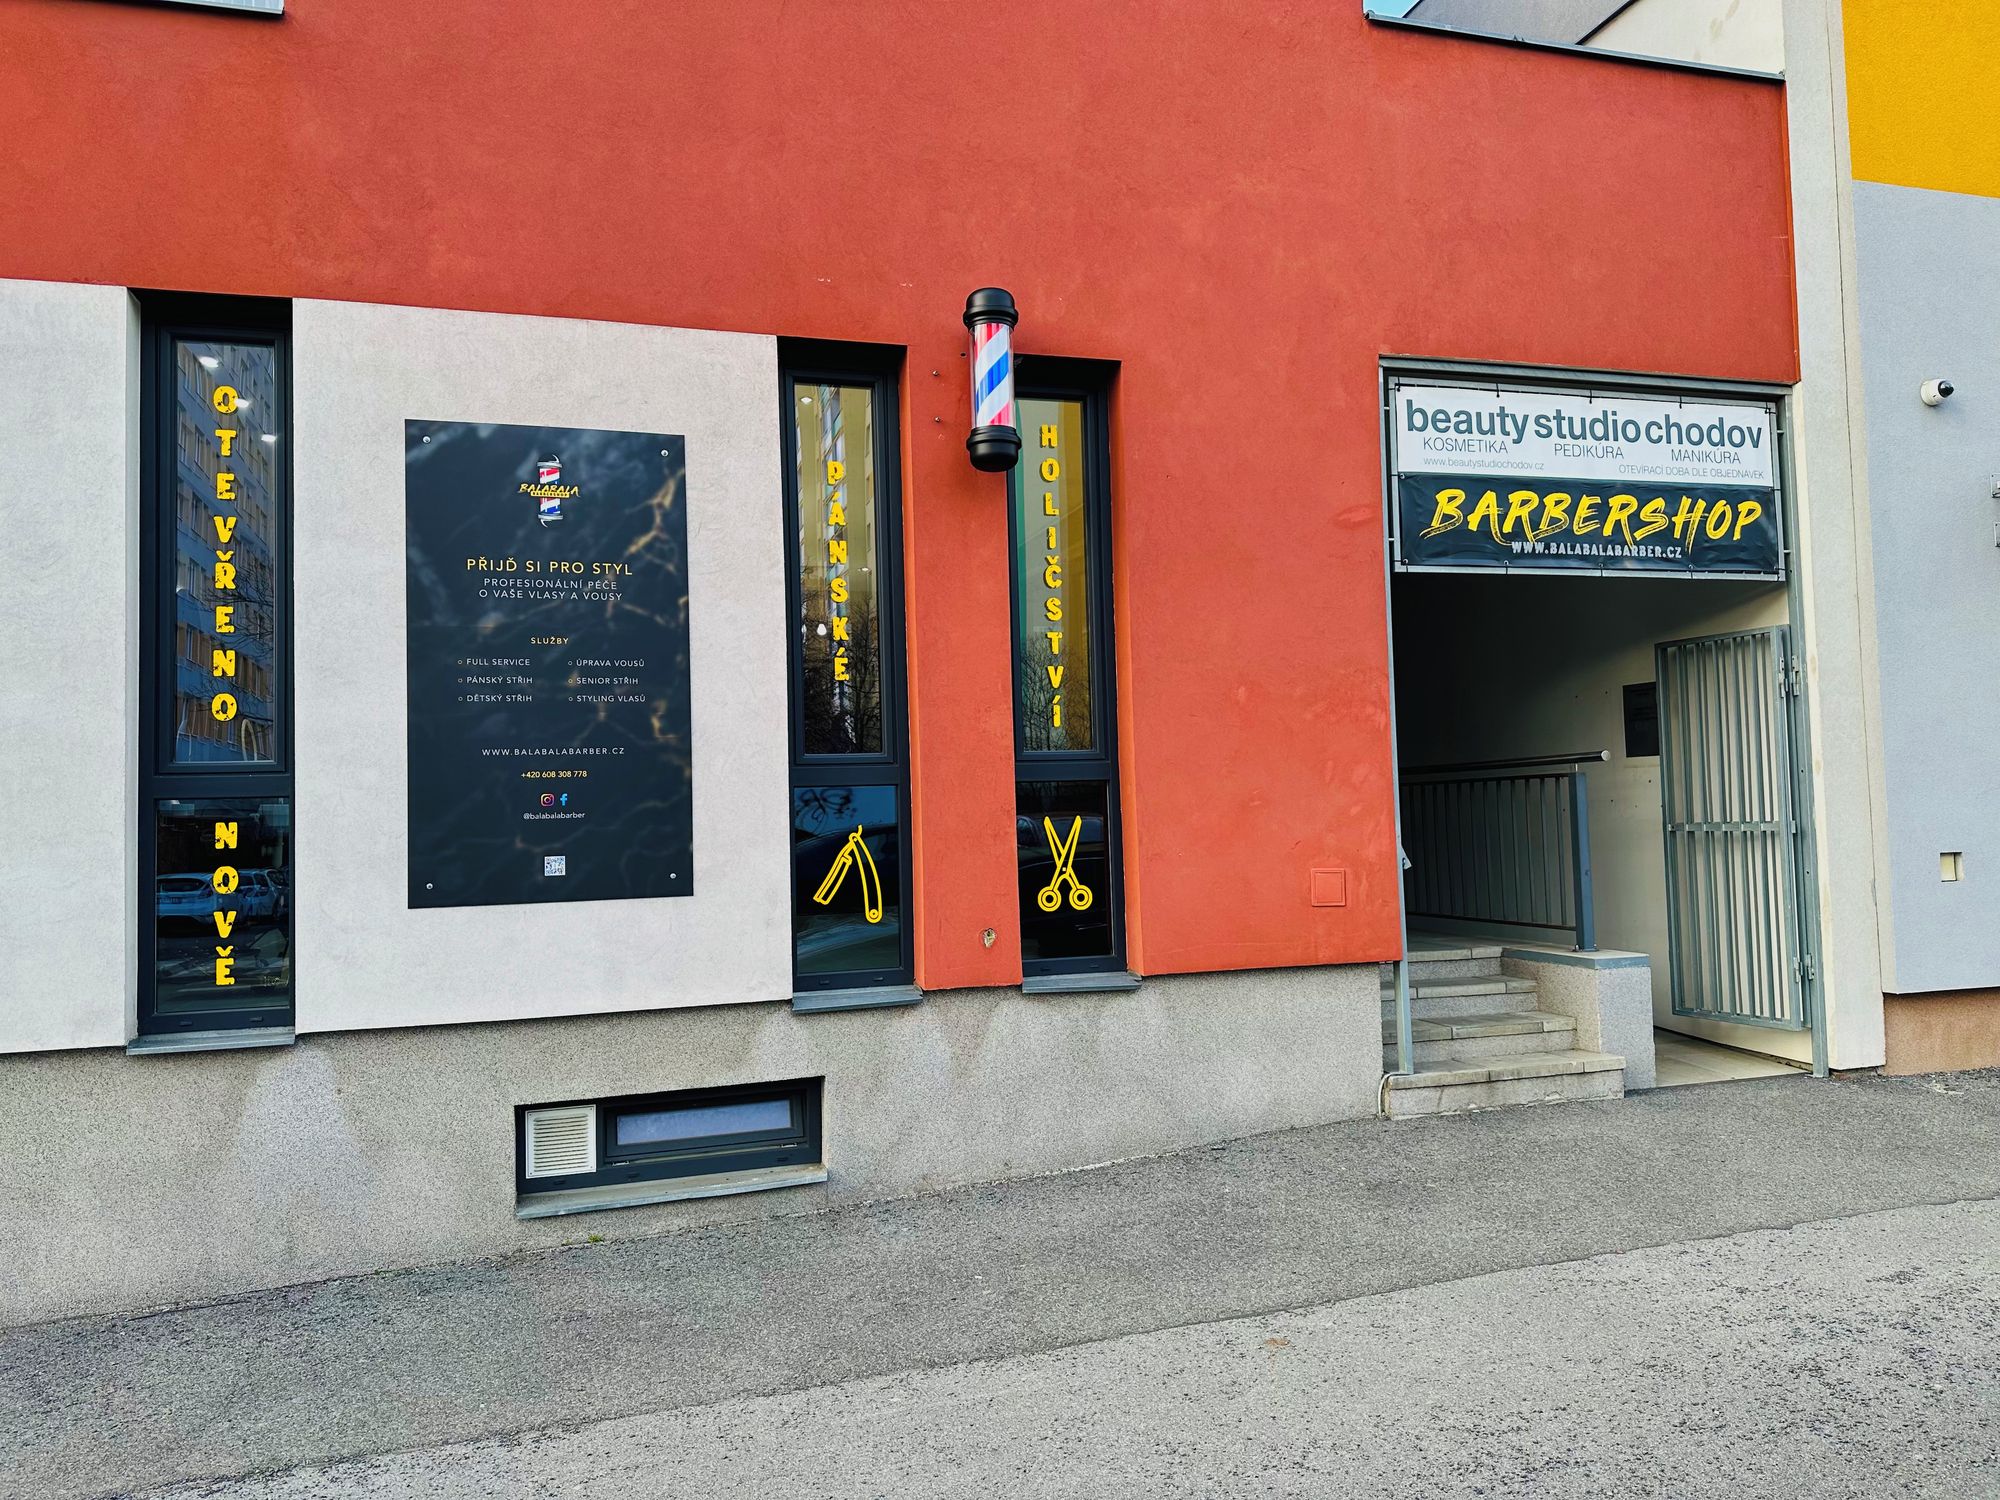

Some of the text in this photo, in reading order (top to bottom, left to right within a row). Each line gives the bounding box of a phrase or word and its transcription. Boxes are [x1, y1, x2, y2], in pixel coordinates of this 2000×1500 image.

[1423, 437, 1741, 464] KOSMETIKA PEDIKÚRA MANIKÚRA
[1423, 457, 1545, 471] www.beautystudiochodov.cz
[1666, 467, 1690, 478] DOBA
[1692, 468, 1708, 478] DLE
[518, 483, 581, 498] BALABALA
[1419, 488, 1762, 555] BARBERSHOP
[211, 385, 240, 722] OTEVŘENO
[1511, 541, 1682, 559] WWW.BALABALABARBER.CZ
[467, 556, 633, 575] PŘIJĎ SI PRO STYL
[827, 461, 849, 681] PÁNSKÉ
[1040, 424, 1064, 728] HOLIČSTVÍ
[484, 578, 617, 590] PROFESIONÁLNÍ PÉČE
[479, 588, 622, 601] O VAŠE VLASY A VOUSY
[531, 636, 569, 645] SLUŽBY
[466, 658, 530, 666] FULL SERVICE
[576, 658, 612, 667] ÚPRAVA
[466, 675, 533, 684] PÁNSKÝ STŘIH
[576, 676, 639, 685] SENIOR STŘIH
[466, 693, 532, 702] DĚTSKÝ STŘIH
[576, 694, 615, 702] STYLING
[481, 747, 625, 756] WWW.BALABALABARBER.CZ
[521, 770, 587, 778] +420 608 308 778
[523, 812, 585, 820] @balabalabarber
[213, 822, 239, 986] NOVĚ
